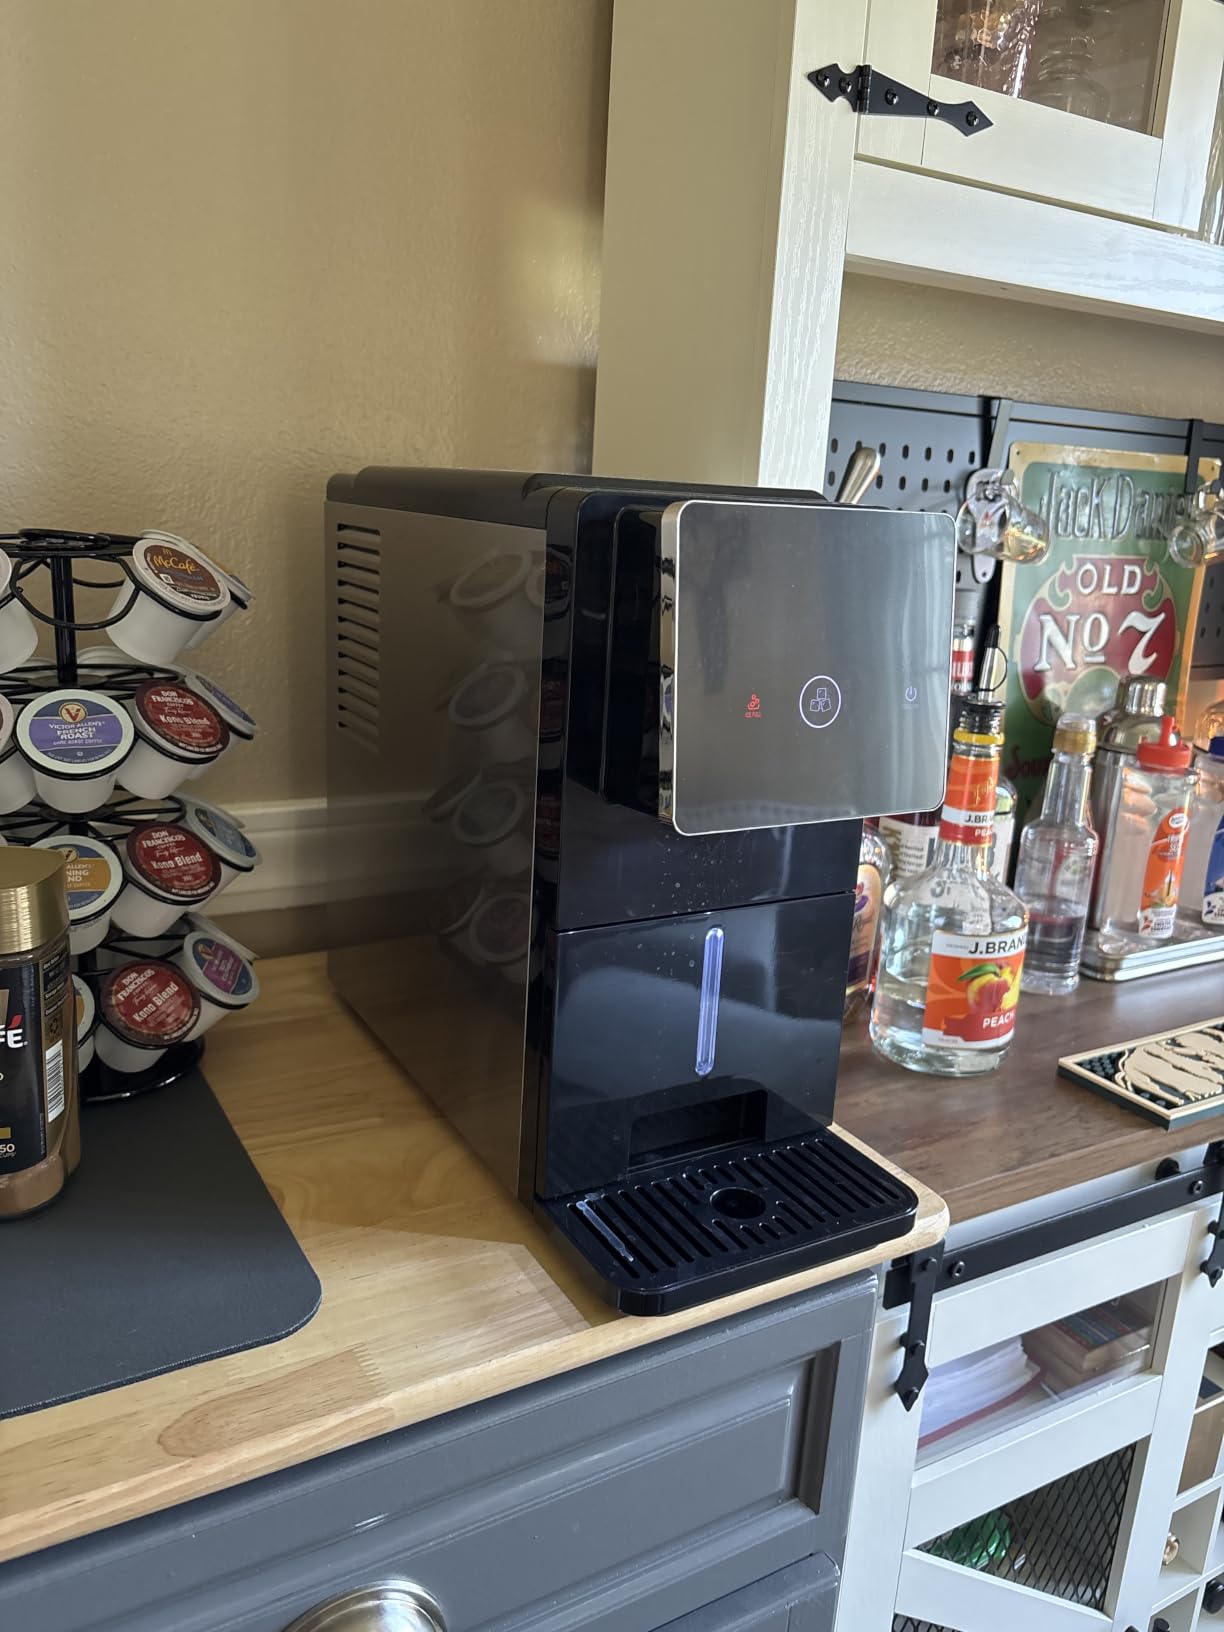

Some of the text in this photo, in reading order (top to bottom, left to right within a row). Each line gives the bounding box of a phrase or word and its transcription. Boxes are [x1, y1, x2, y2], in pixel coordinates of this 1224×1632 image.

[153, 555, 198, 574] McCafé
[1077, 562, 1143, 595] OLD
[1118, 610, 1166, 675] 7
[159, 714, 211, 725] Kona Blend
[56, 726, 97, 736] FRENCH
[60, 731, 94, 740] ROAST
[151, 830, 168, 839] DON
[150, 859, 176, 870] Kona
[175, 852, 203, 867] Blend
[122, 972, 139, 986] DON
[132, 1003, 157, 1022] Kona
[152, 981, 179, 1006] Blend
[982, 1012, 1014, 1029] PEACH
